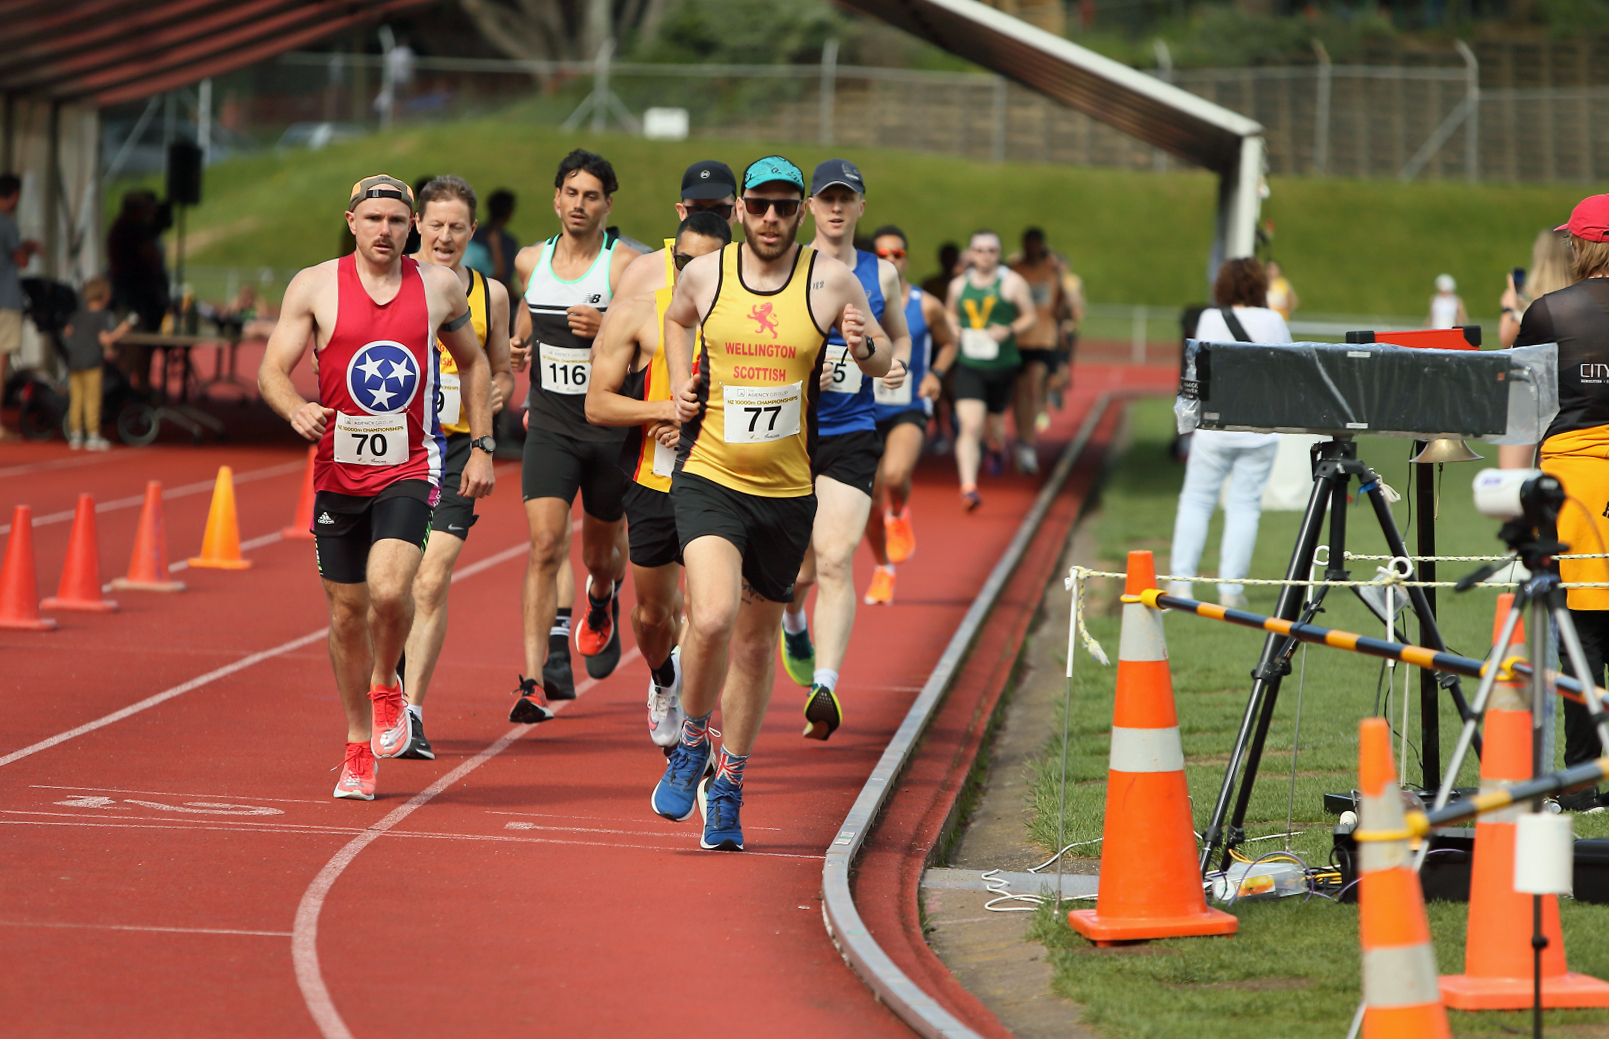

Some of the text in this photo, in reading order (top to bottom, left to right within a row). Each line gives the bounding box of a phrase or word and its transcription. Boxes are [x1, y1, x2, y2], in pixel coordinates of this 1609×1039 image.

[725, 342, 797, 359] WELLINGTON
[549, 363, 587, 385] 116
[733, 365, 786, 382] SCOTTISH
[757, 396, 798, 405] CHAMPIONSHIPS
[744, 405, 782, 432] 77
[351, 433, 388, 457] 70
